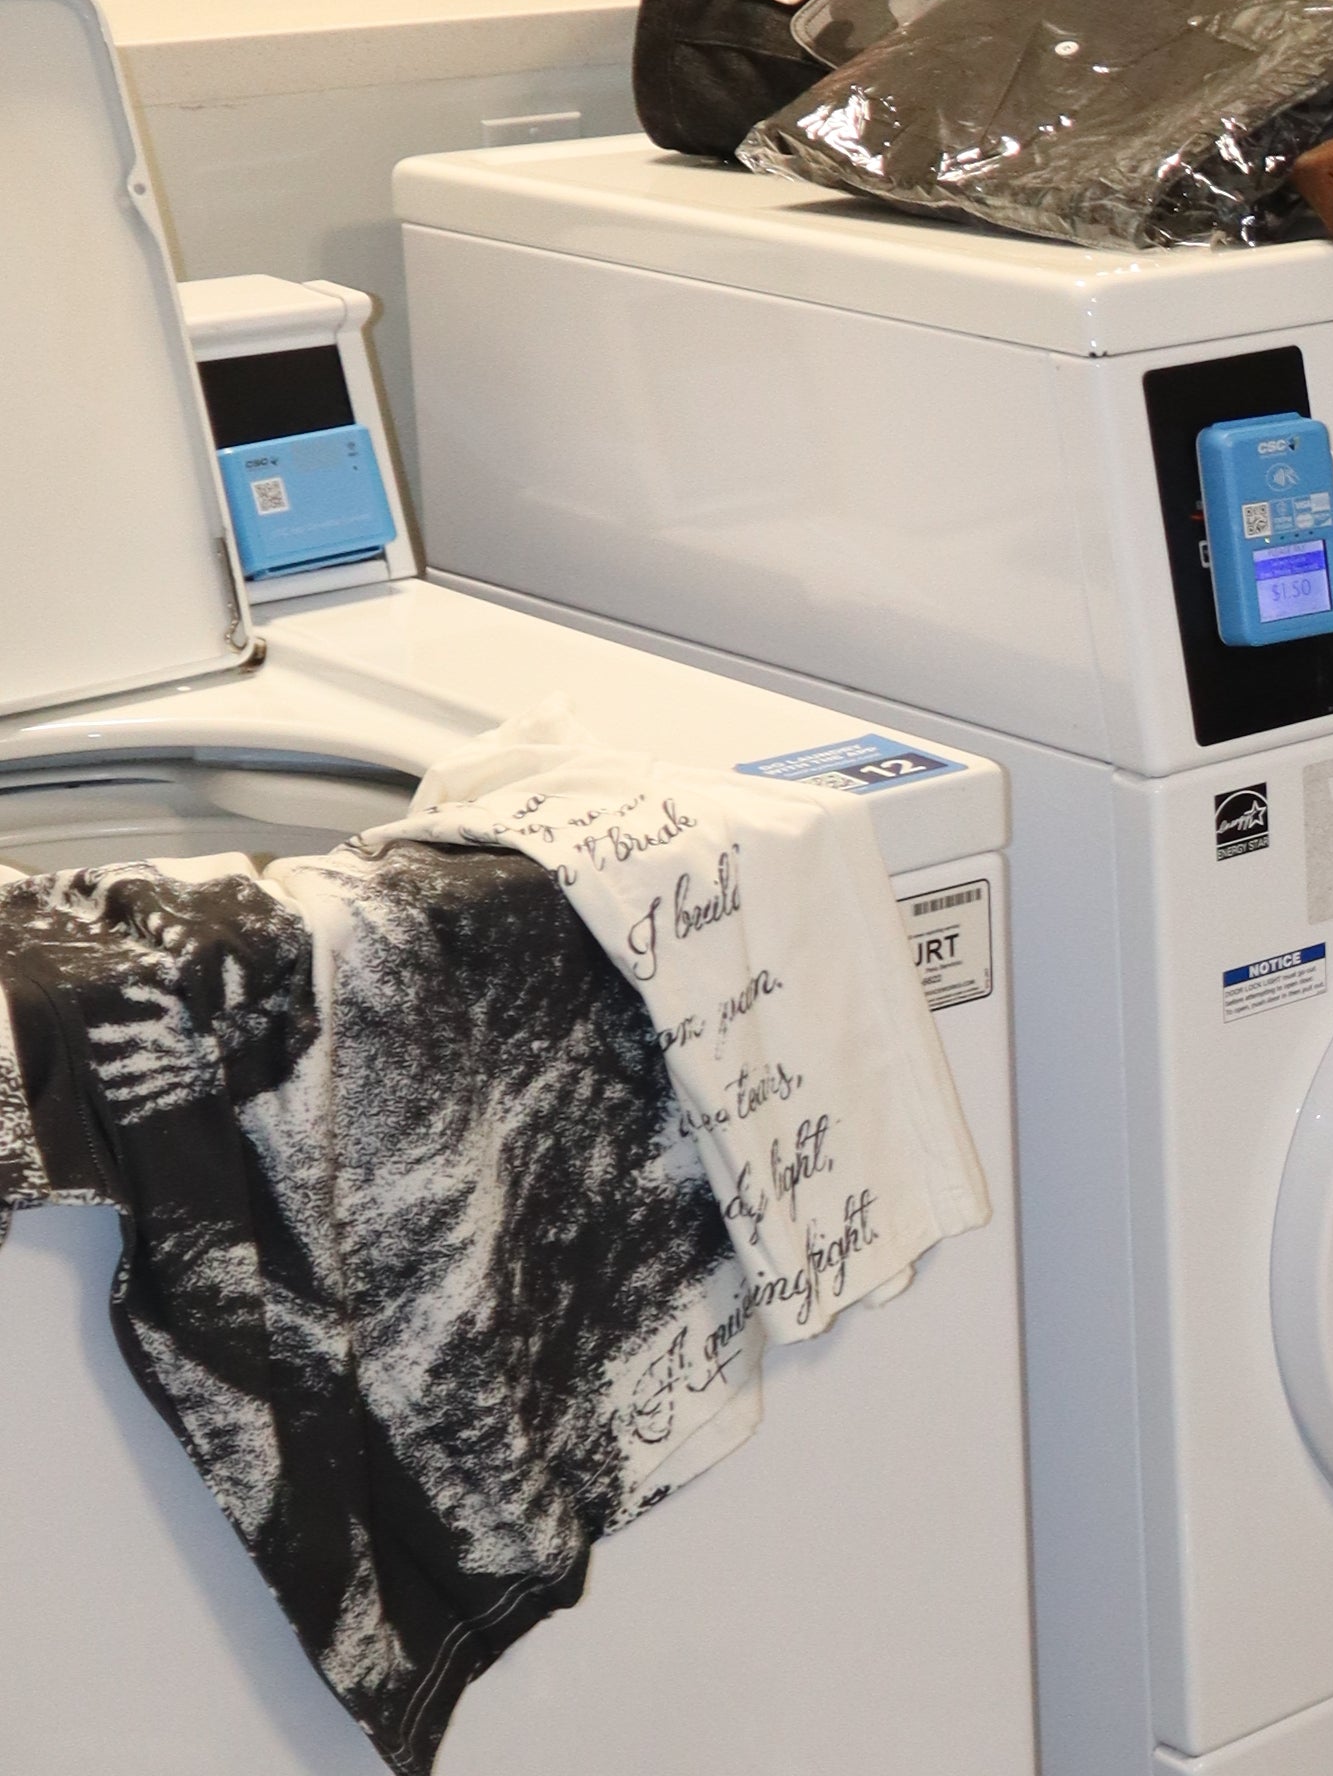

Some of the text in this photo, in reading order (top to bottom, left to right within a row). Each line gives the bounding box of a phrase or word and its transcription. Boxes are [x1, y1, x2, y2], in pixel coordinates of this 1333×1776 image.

[1257, 439, 1288, 455] CSC
[1271, 578, 1312, 602] $1.50
[860, 759, 927, 778] 12
[1217, 835, 1269, 860] ENERGY STAR
[1248, 952, 1302, 979] NOTICE
